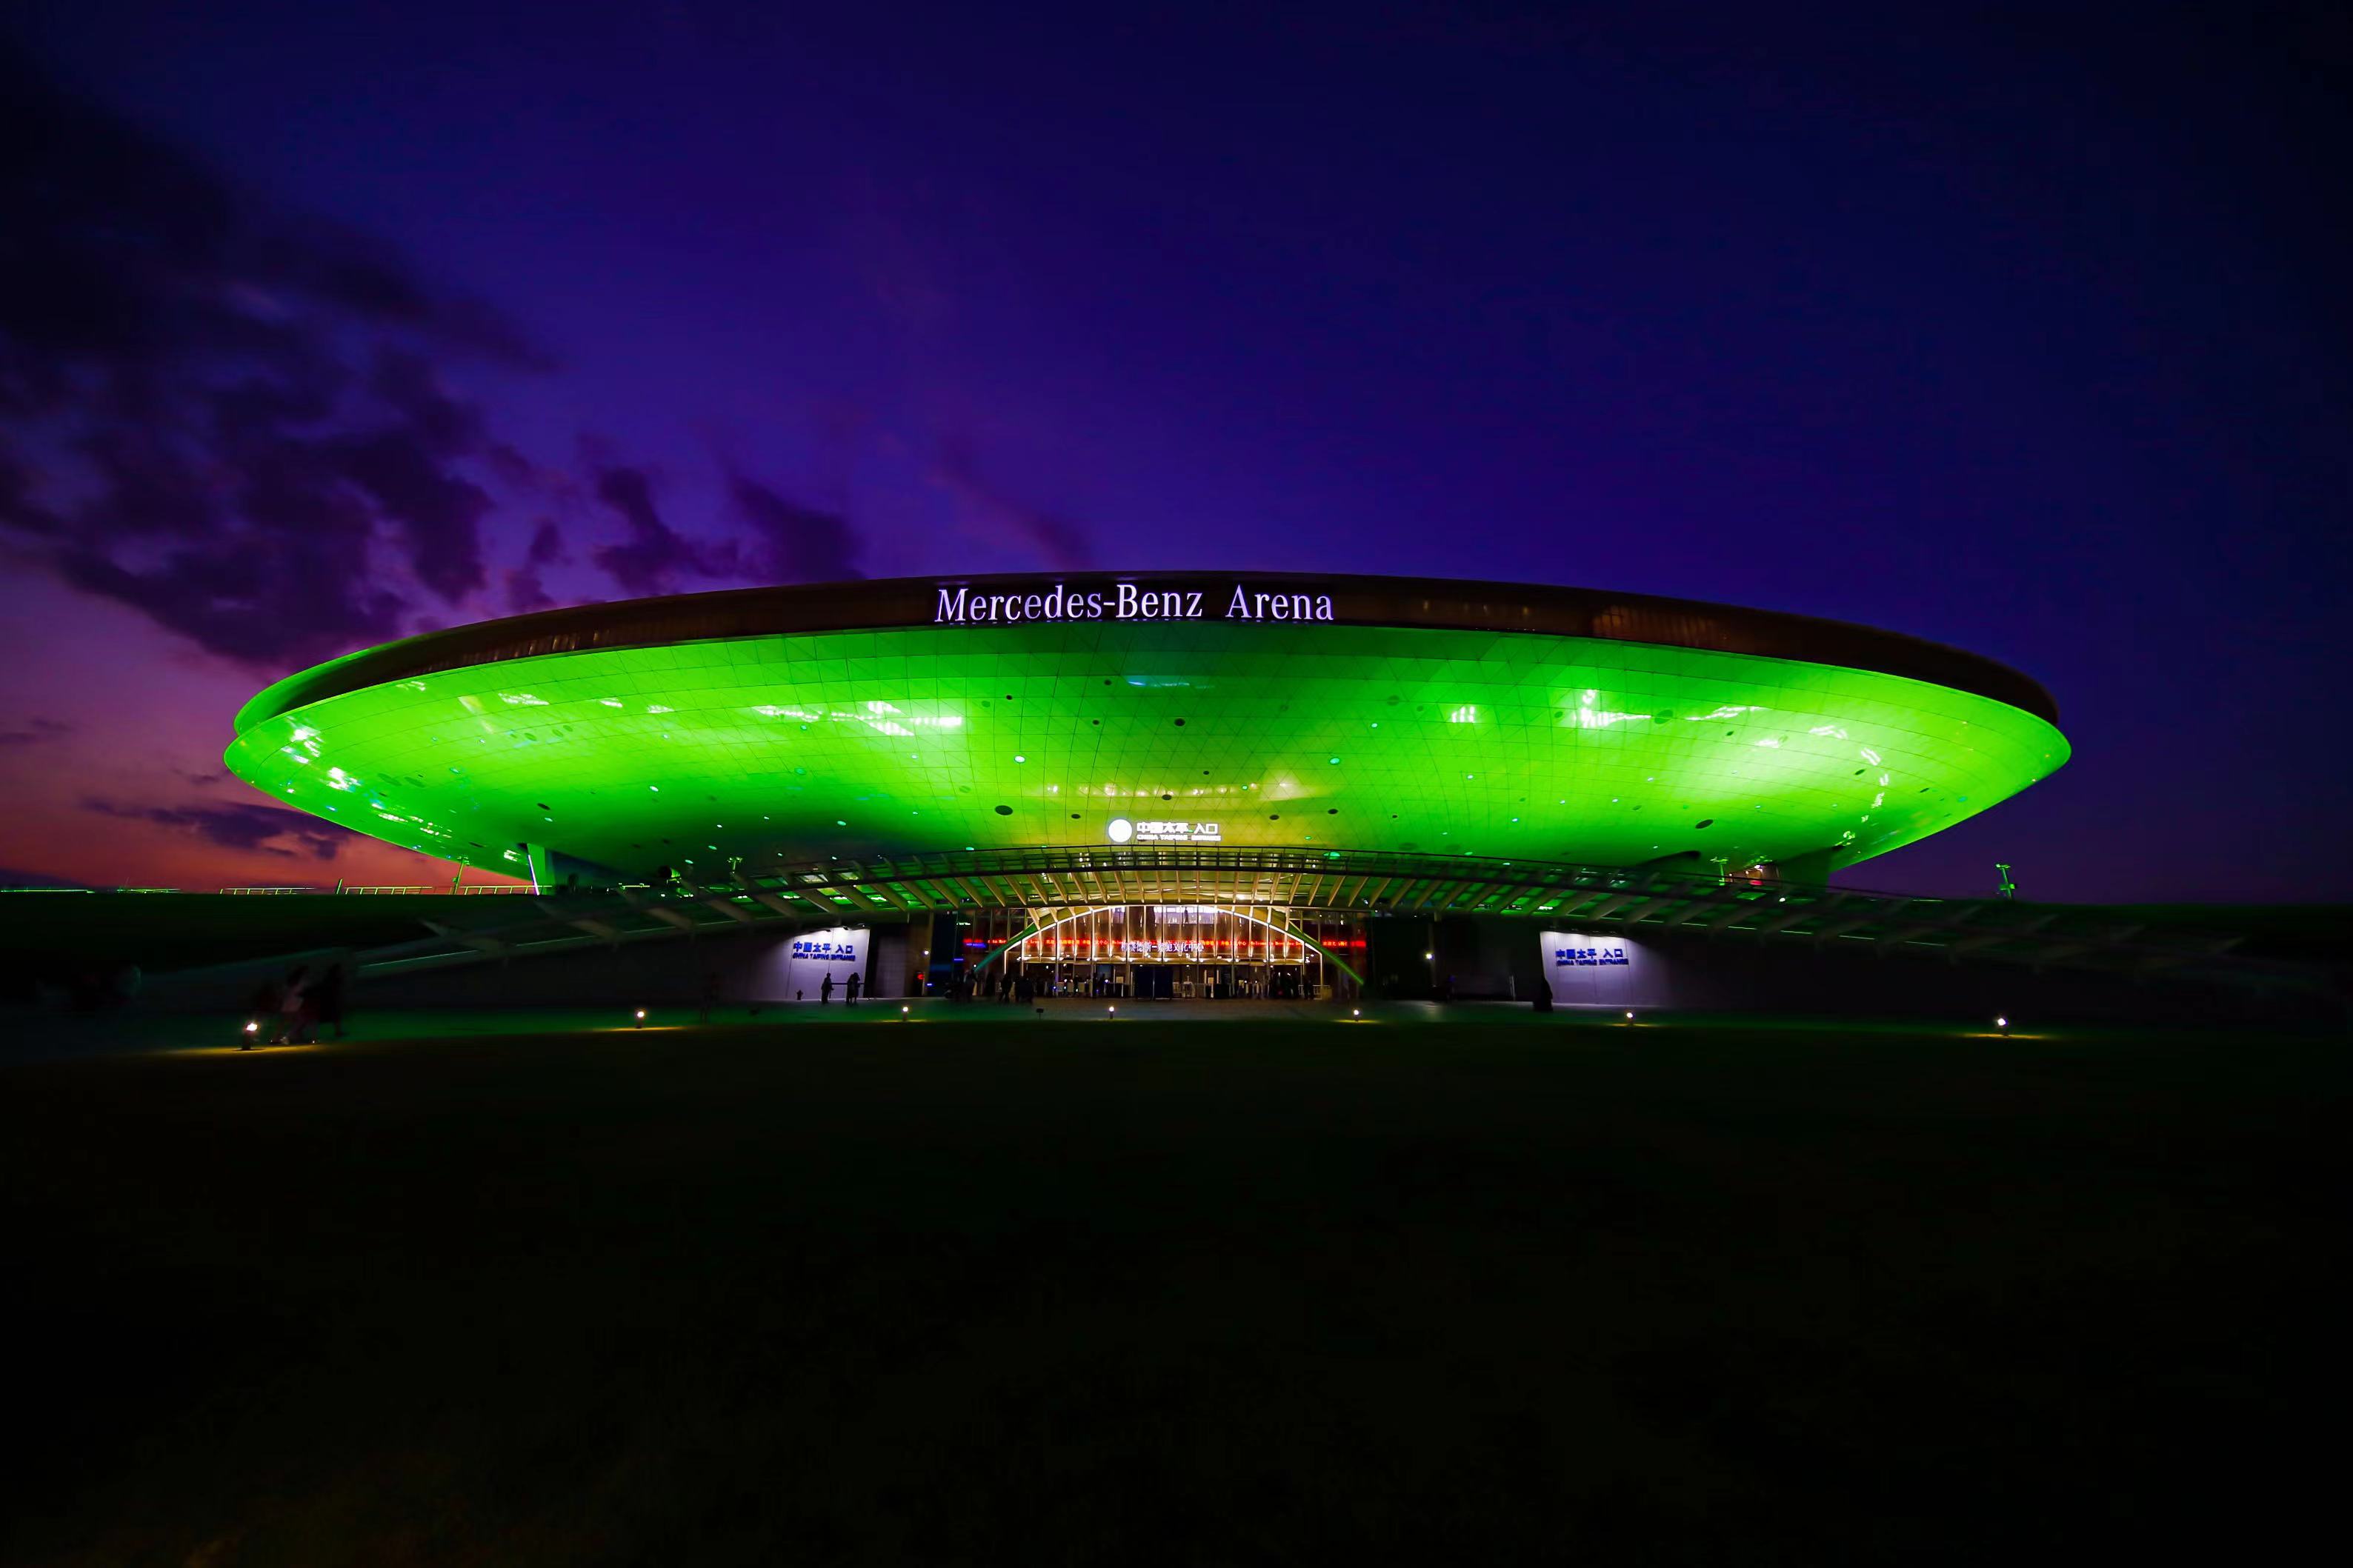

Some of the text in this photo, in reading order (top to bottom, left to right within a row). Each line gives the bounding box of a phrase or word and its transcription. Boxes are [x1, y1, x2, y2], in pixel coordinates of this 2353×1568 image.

[934, 584, 1334, 621] Mercedes-Benz Arena
[1193, 823, 1218, 835] 入口
[793, 941, 853, 954] 中国太平 入口
[1603, 948, 1623, 958] 入口
